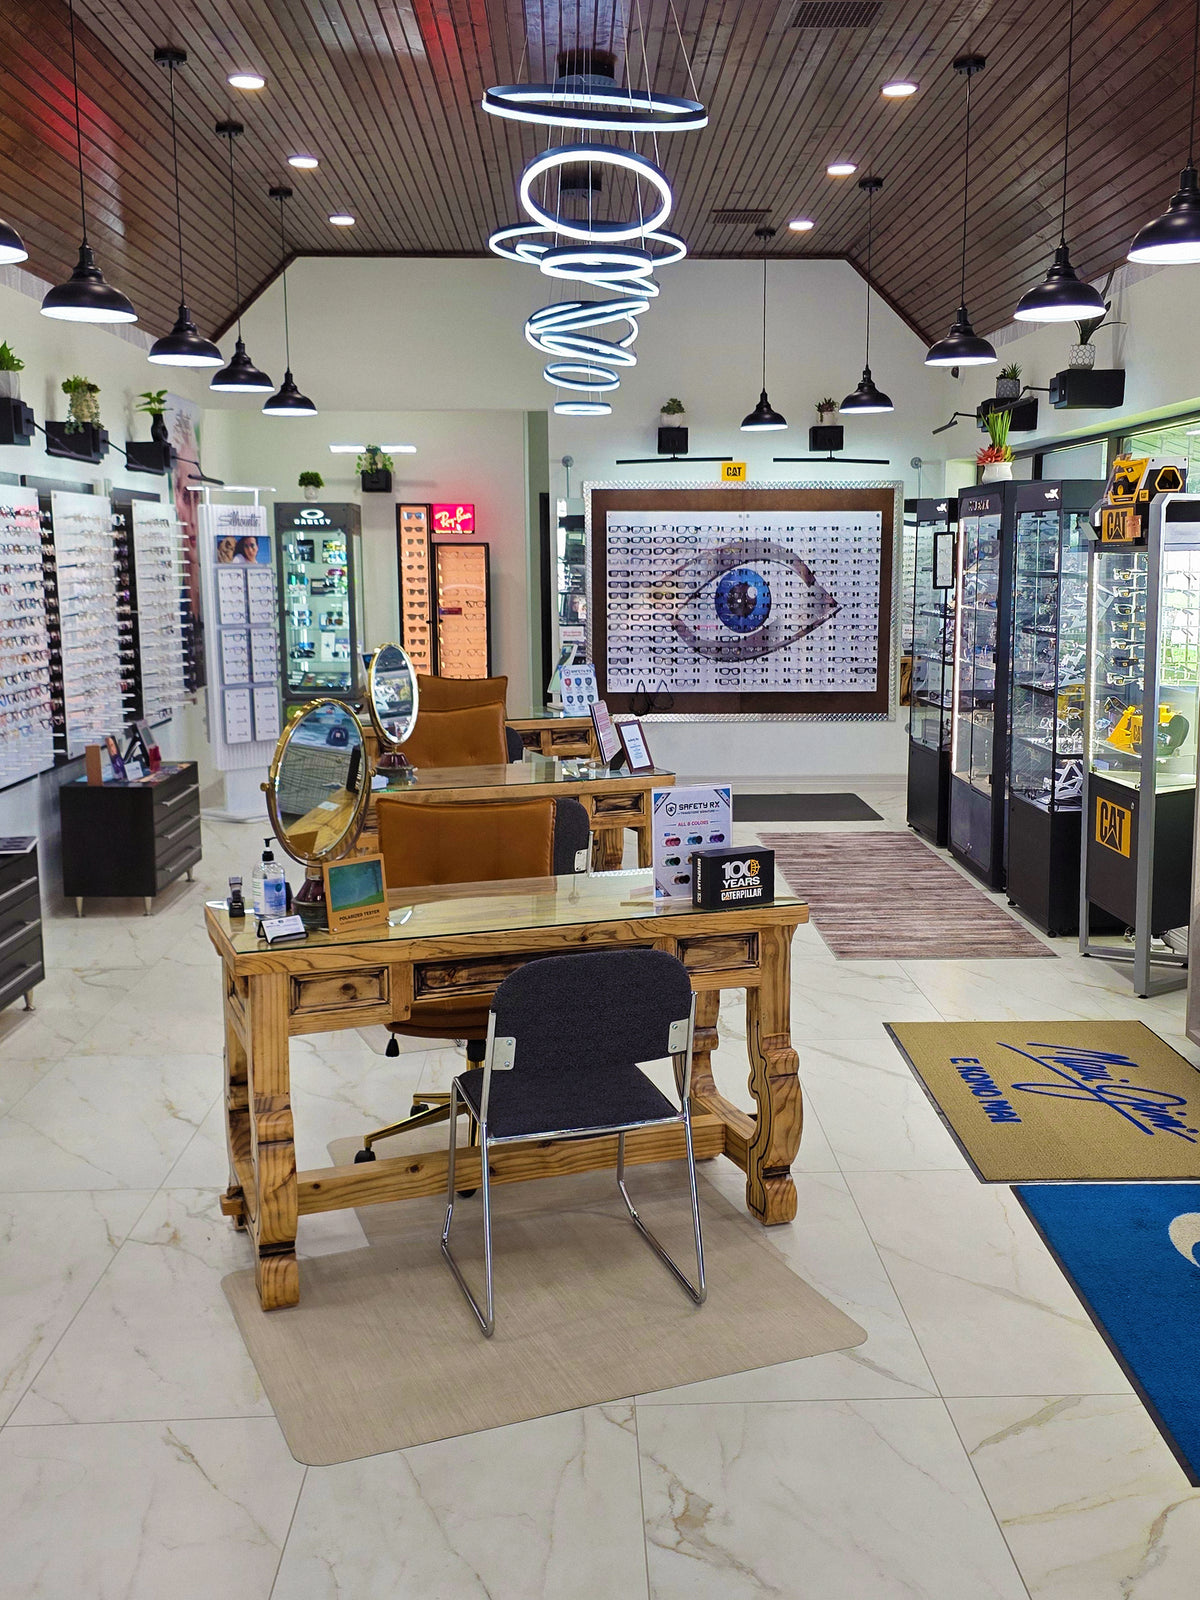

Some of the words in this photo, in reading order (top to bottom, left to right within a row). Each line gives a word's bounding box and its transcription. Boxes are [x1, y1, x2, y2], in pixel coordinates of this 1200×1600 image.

[726, 466, 742, 477] CAT
[217, 510, 261, 527] Silhouette
[293, 518, 332, 526] OAKLEY
[435, 506, 472, 528] Ray-Ban
[1107, 511, 1128, 541] CAT
[678, 802, 708, 811] SAFETY
[709, 801, 720, 809] RX
[1100, 801, 1125, 852] CAT
[721, 859, 760, 880] 100
[722, 876, 761, 889] YEARS
[721, 887, 762, 902] CATERPILLAR
[950, 1057, 981, 1065] E
[956, 1066, 1003, 1098] KOMO
[979, 1099, 1022, 1123] MAI
